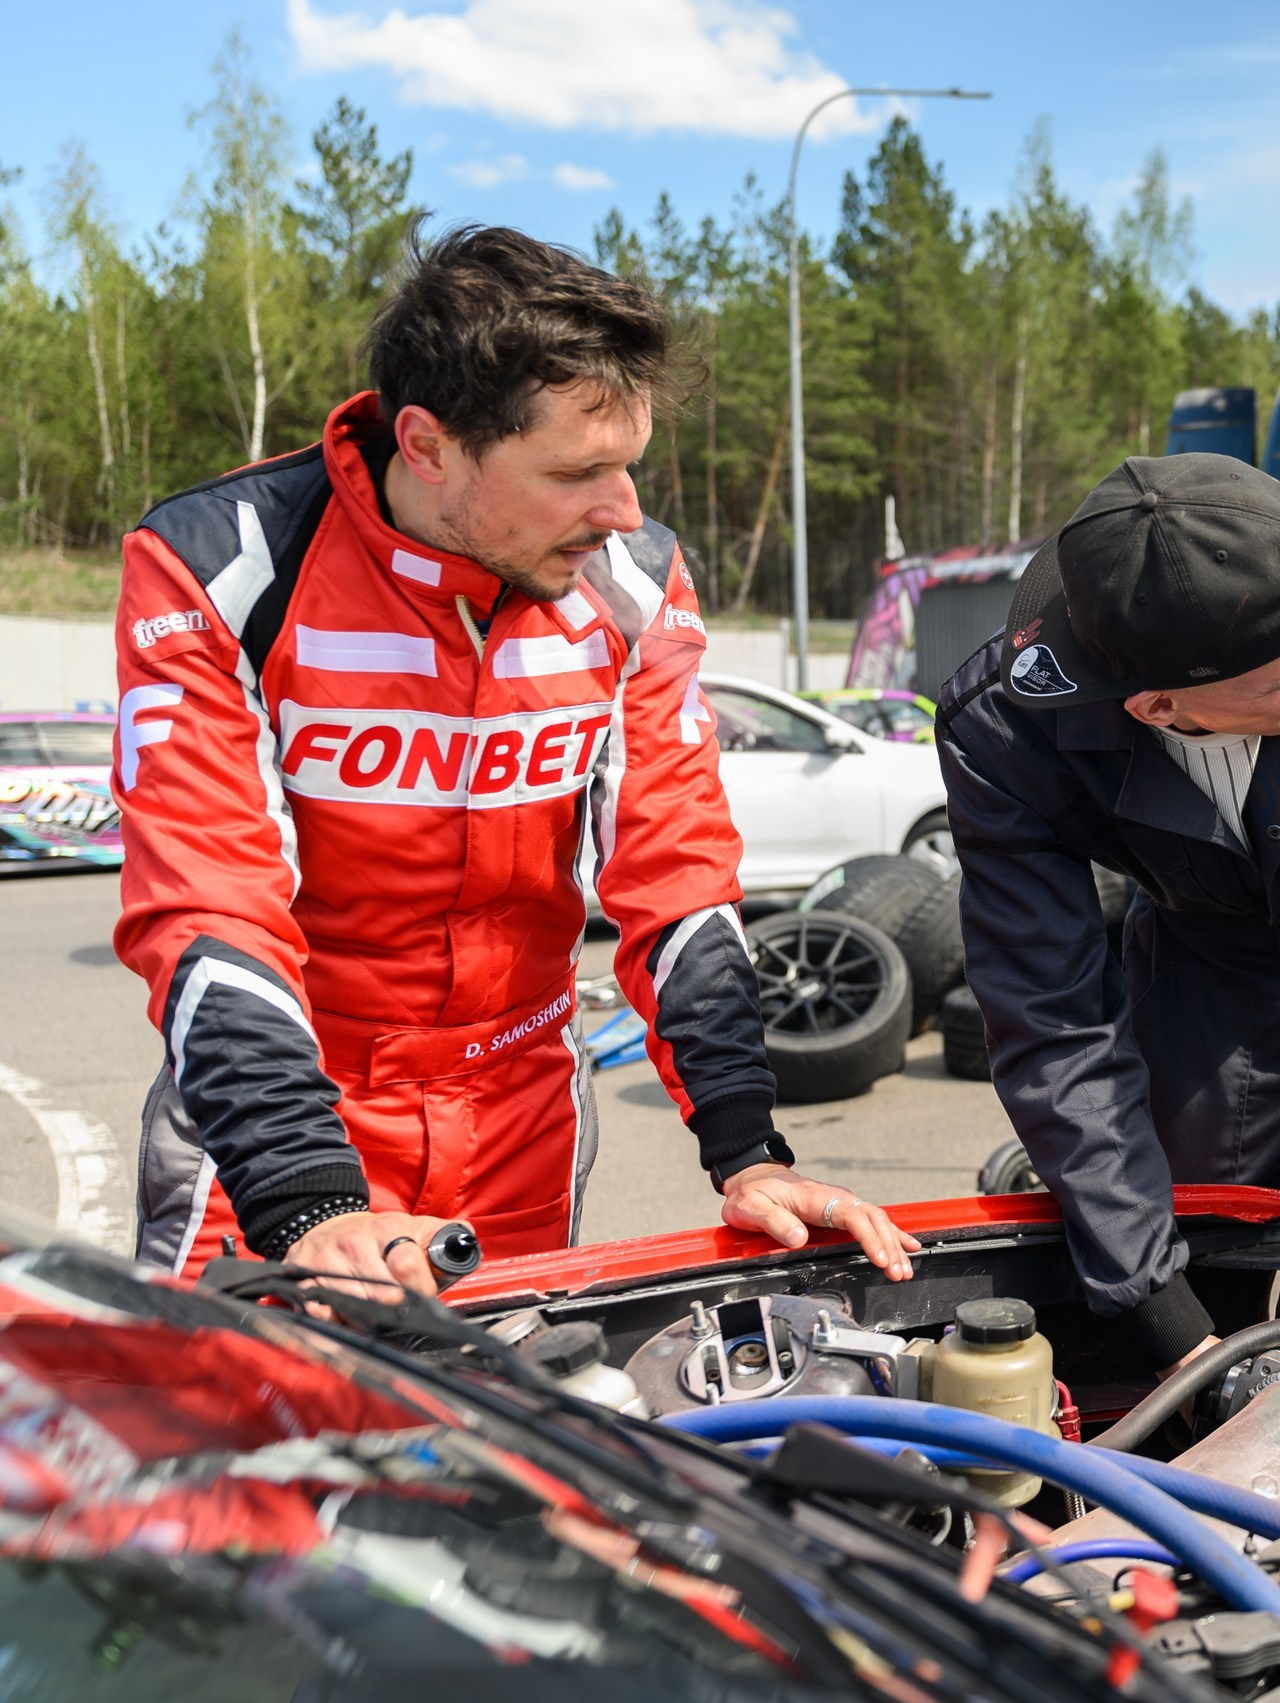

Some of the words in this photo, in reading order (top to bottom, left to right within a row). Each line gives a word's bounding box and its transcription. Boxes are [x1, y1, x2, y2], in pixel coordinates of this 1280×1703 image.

[664, 603, 706, 635] free
[1027, 673, 1047, 687] VISOR
[1030, 665, 1051, 679] FLAT
[119, 683, 185, 793] F
[282, 713, 612, 795] FONBET
[465, 1042, 485, 1059] D.
[490, 989, 572, 1052] SAMOSHKIN
